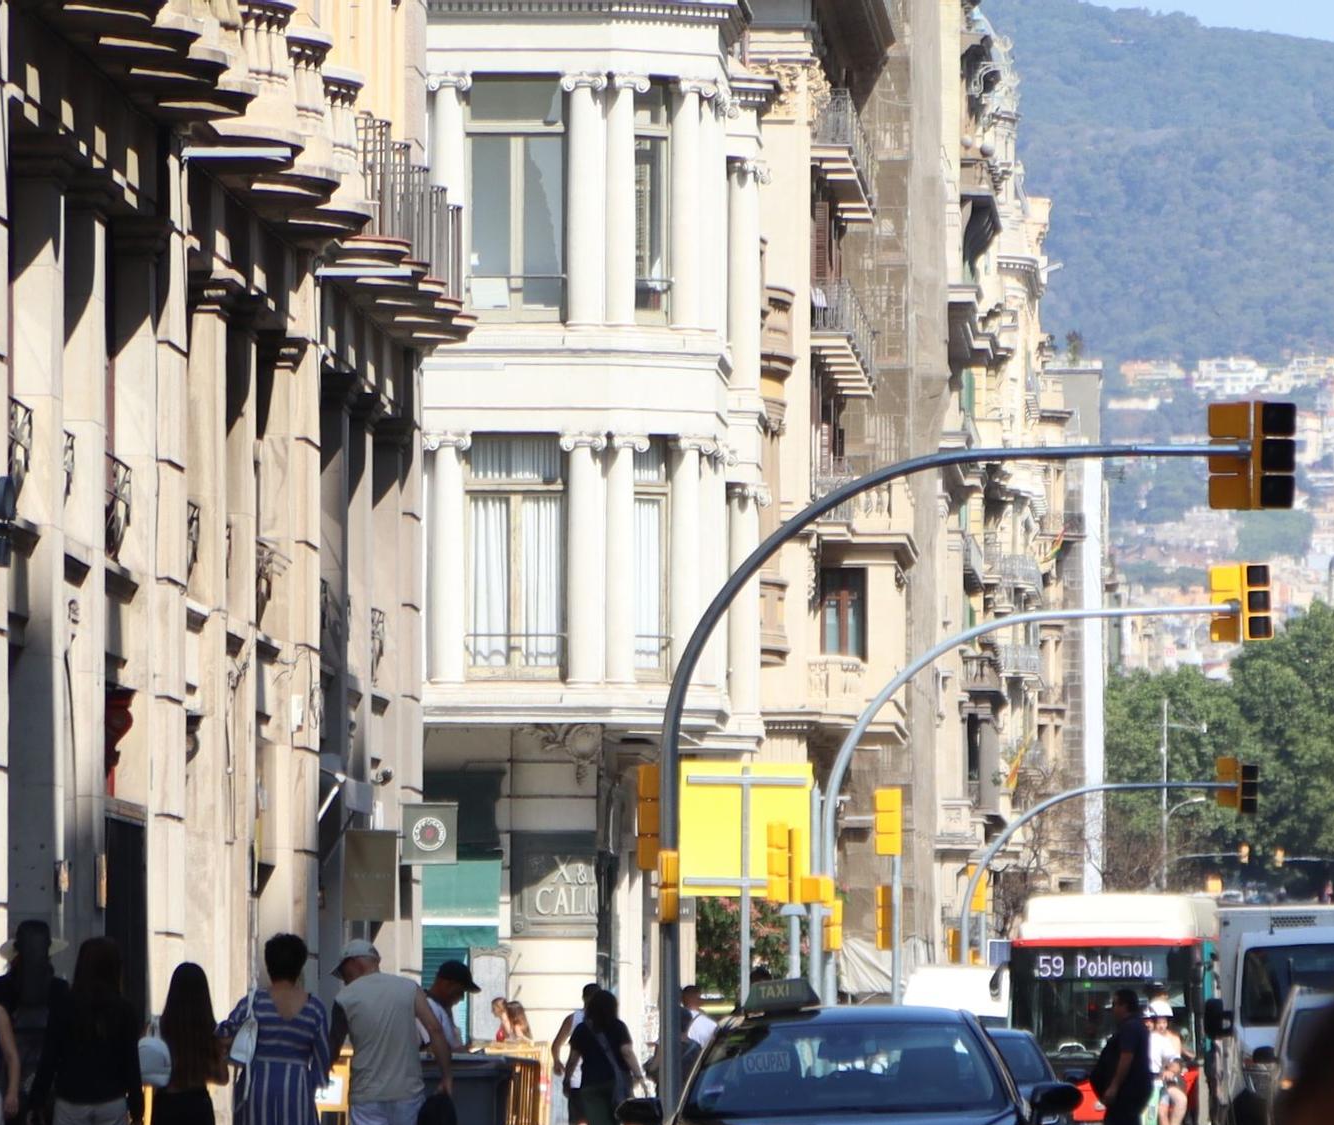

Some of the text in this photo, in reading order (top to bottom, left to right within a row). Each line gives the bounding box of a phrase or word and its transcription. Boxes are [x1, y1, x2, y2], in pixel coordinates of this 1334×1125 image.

[1038, 954, 1153, 978] 59 Poblenou
[759, 984, 790, 999] TAXI
